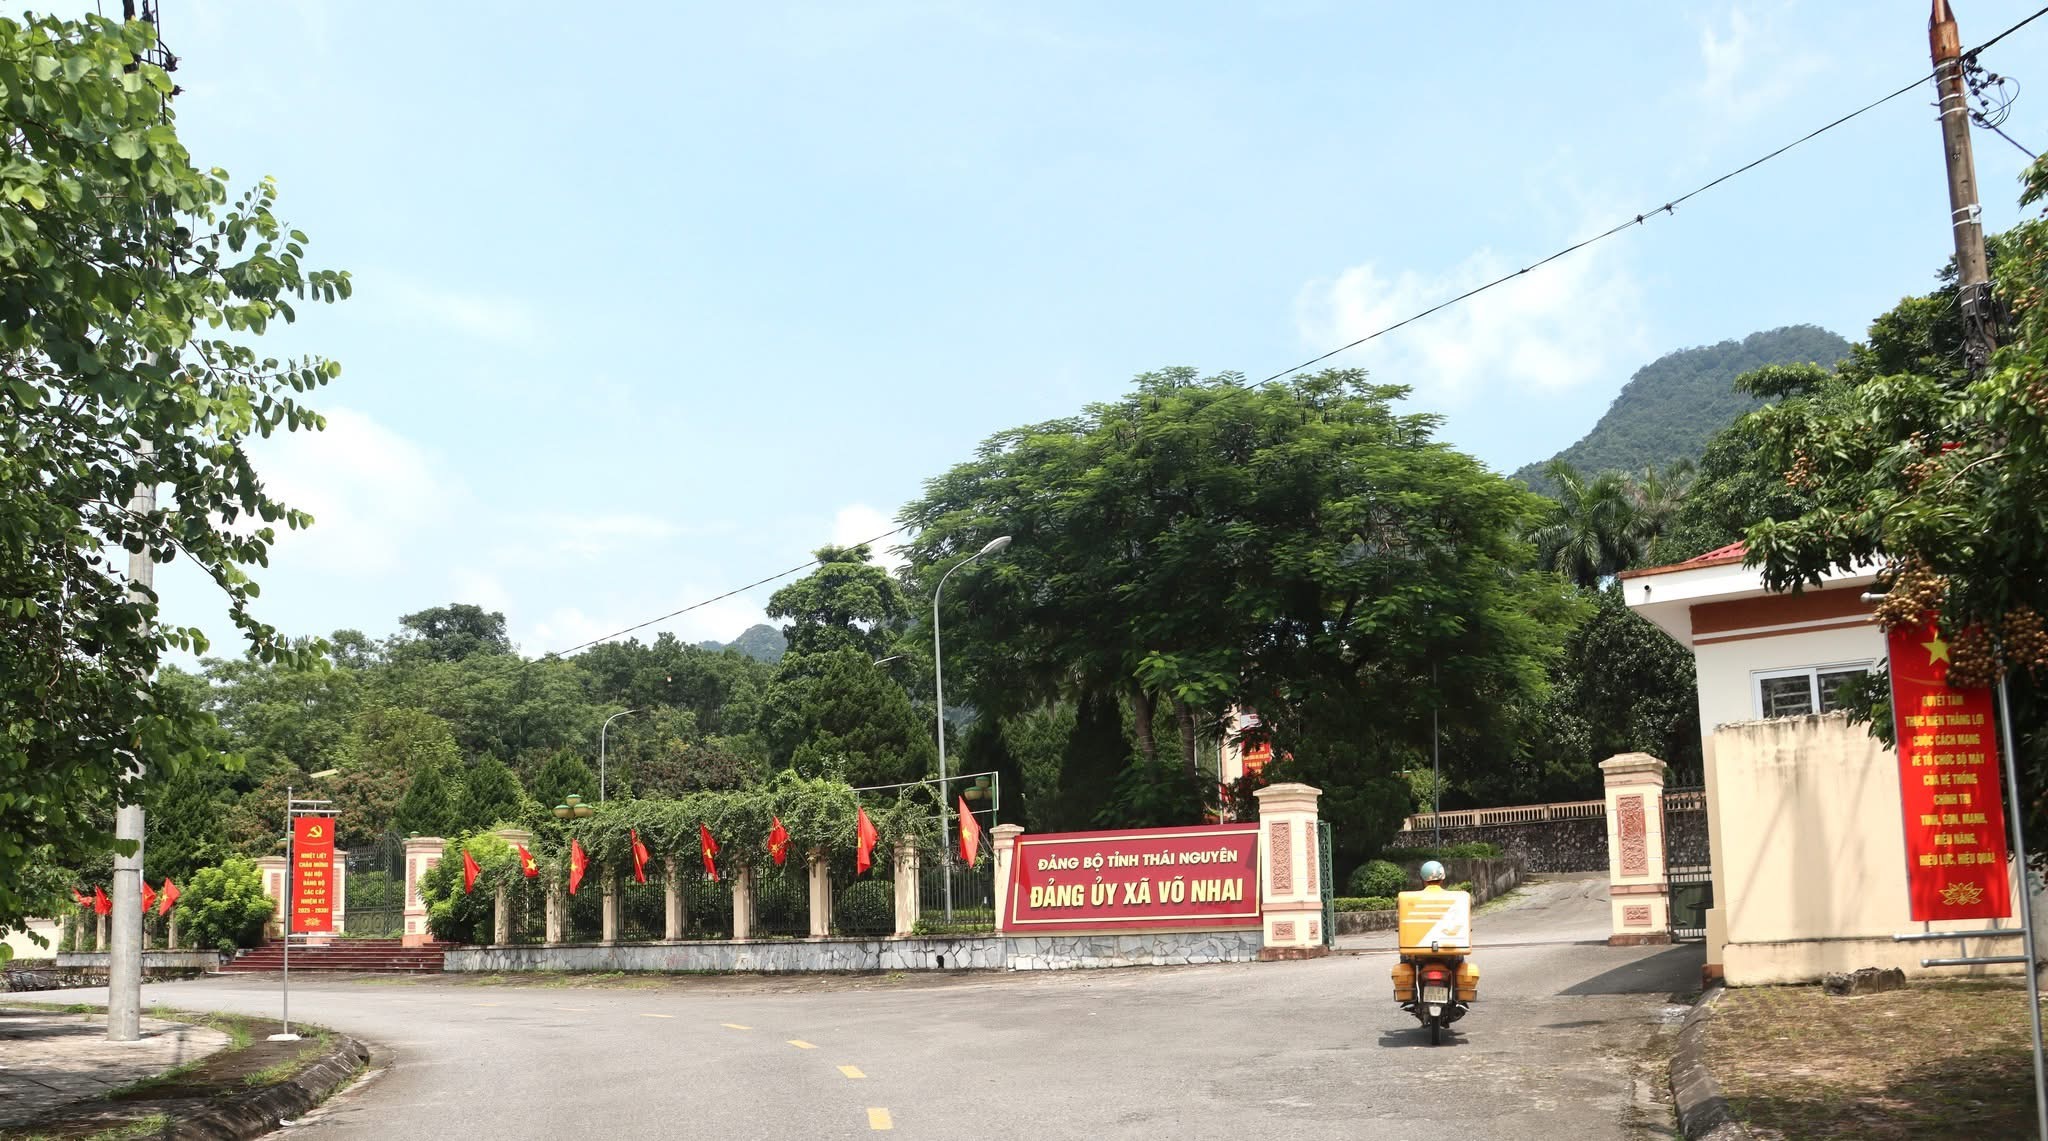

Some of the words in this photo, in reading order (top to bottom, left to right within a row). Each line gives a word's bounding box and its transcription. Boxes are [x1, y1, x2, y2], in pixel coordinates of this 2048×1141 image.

[1038, 854, 1080, 871] ĐẢNG
[1083, 853, 1104, 871] BỘ
[1107, 851, 1139, 868] TỈNH
[1142, 850, 1175, 867] THÁI
[1179, 847, 1238, 864] NGUYÊN
[1030, 878, 1085, 908] ĐẢNG
[1091, 876, 1118, 906] ỦY
[1122, 877, 1151, 905] XÃ
[1158, 875, 1185, 904] VÕ
[1190, 877, 1244, 903] NHAI
